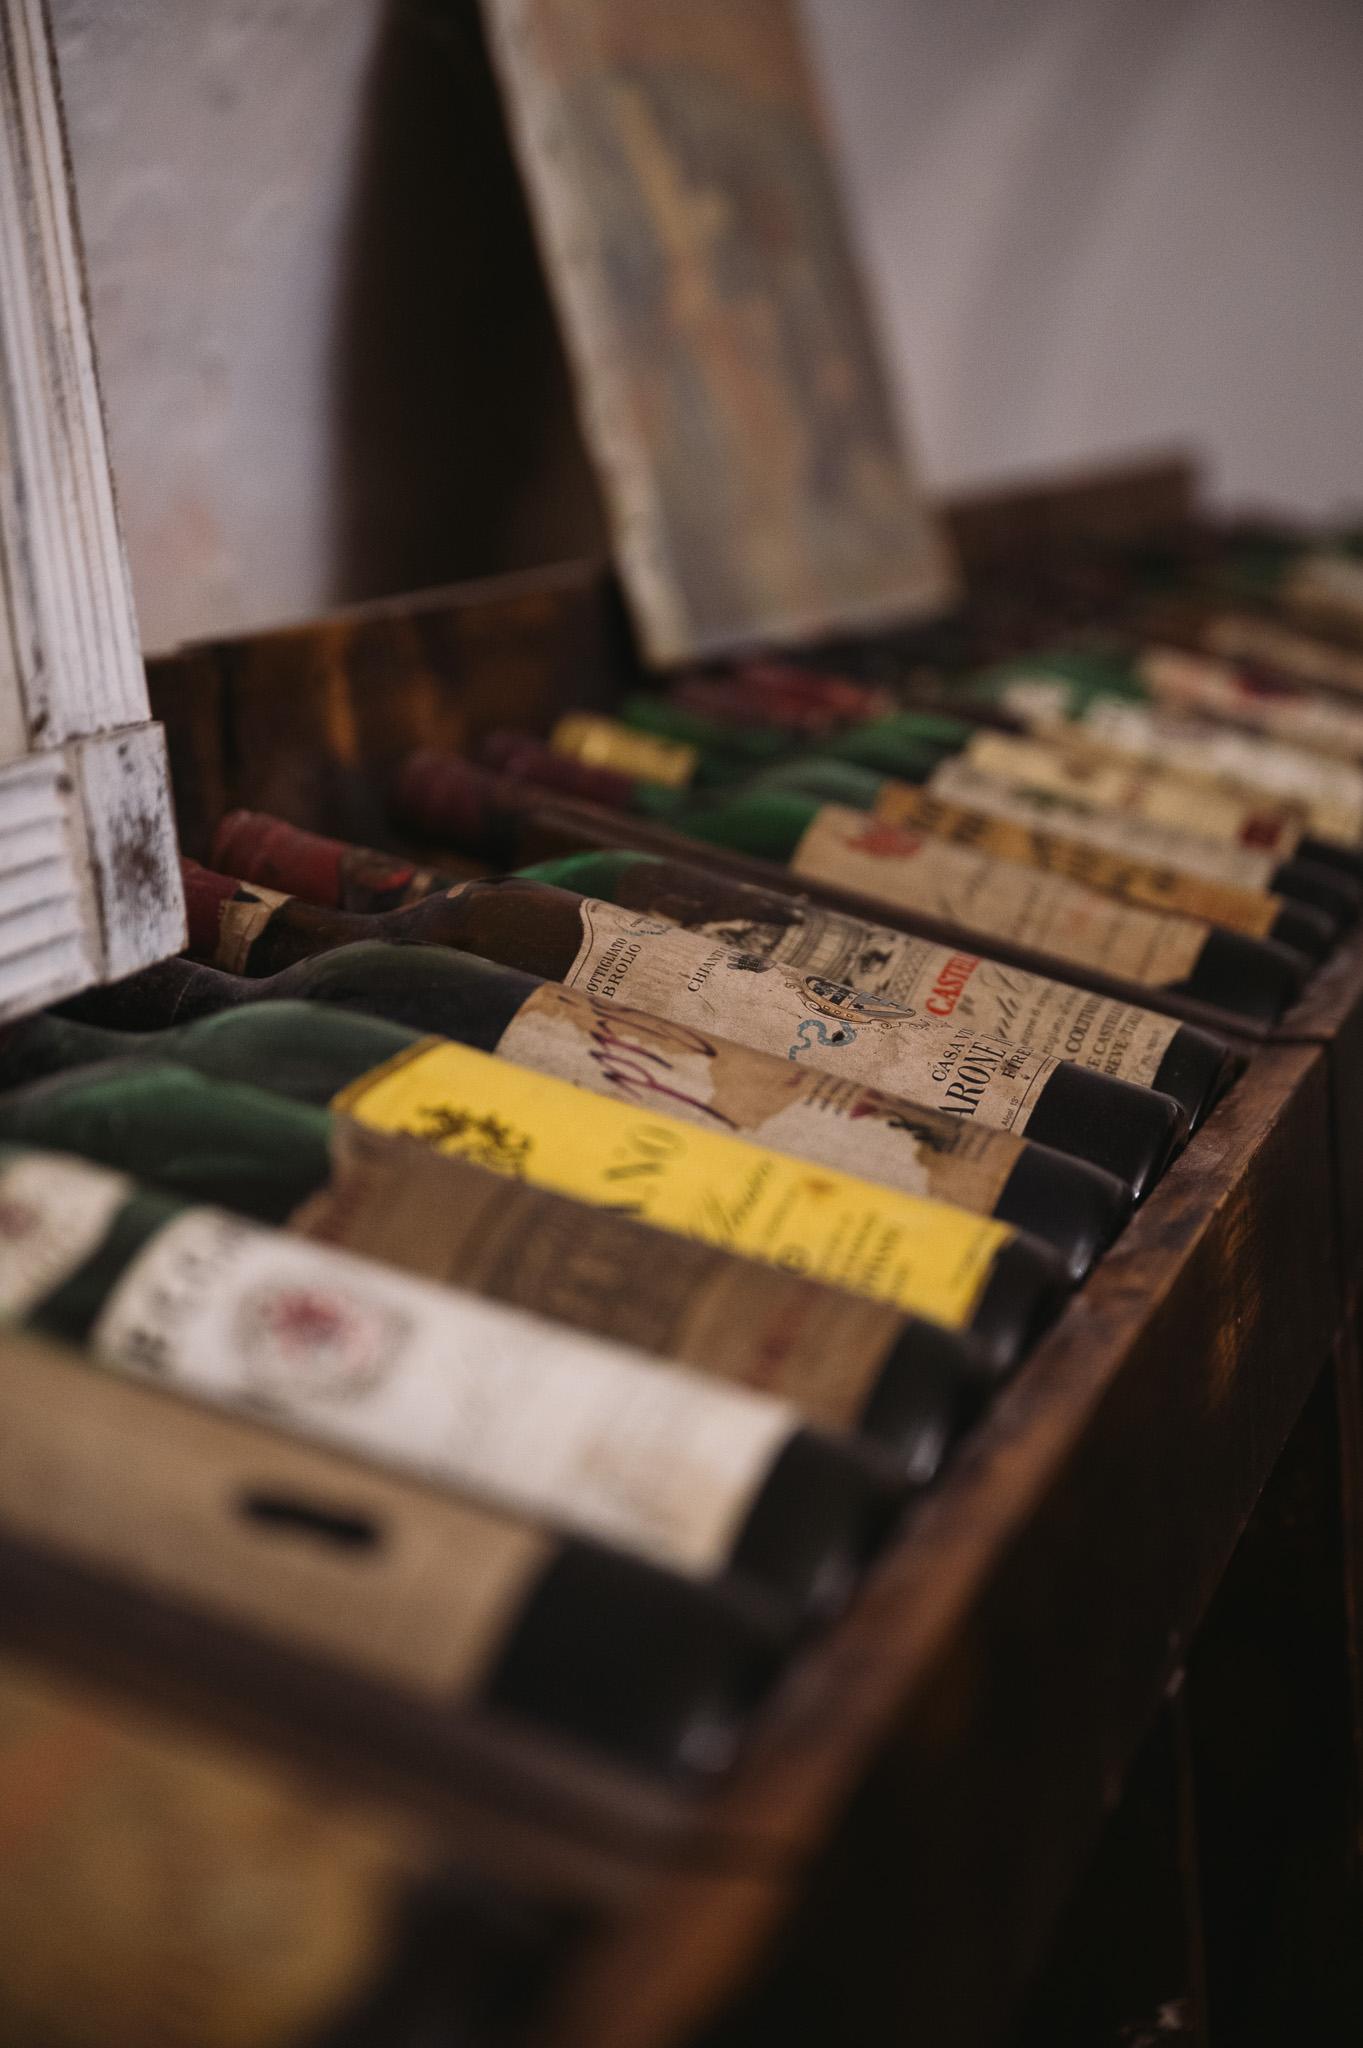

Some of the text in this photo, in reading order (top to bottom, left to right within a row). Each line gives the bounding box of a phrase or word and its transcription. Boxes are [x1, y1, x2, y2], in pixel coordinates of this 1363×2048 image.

[585, 938, 628, 994] OTTIGLIATO
[602, 943, 641, 998] BROLIO
[931, 1038, 964, 1082] CASA
[938, 1041, 1006, 1117] ARONE
[1104, 1040, 1128, 1076] REVE
